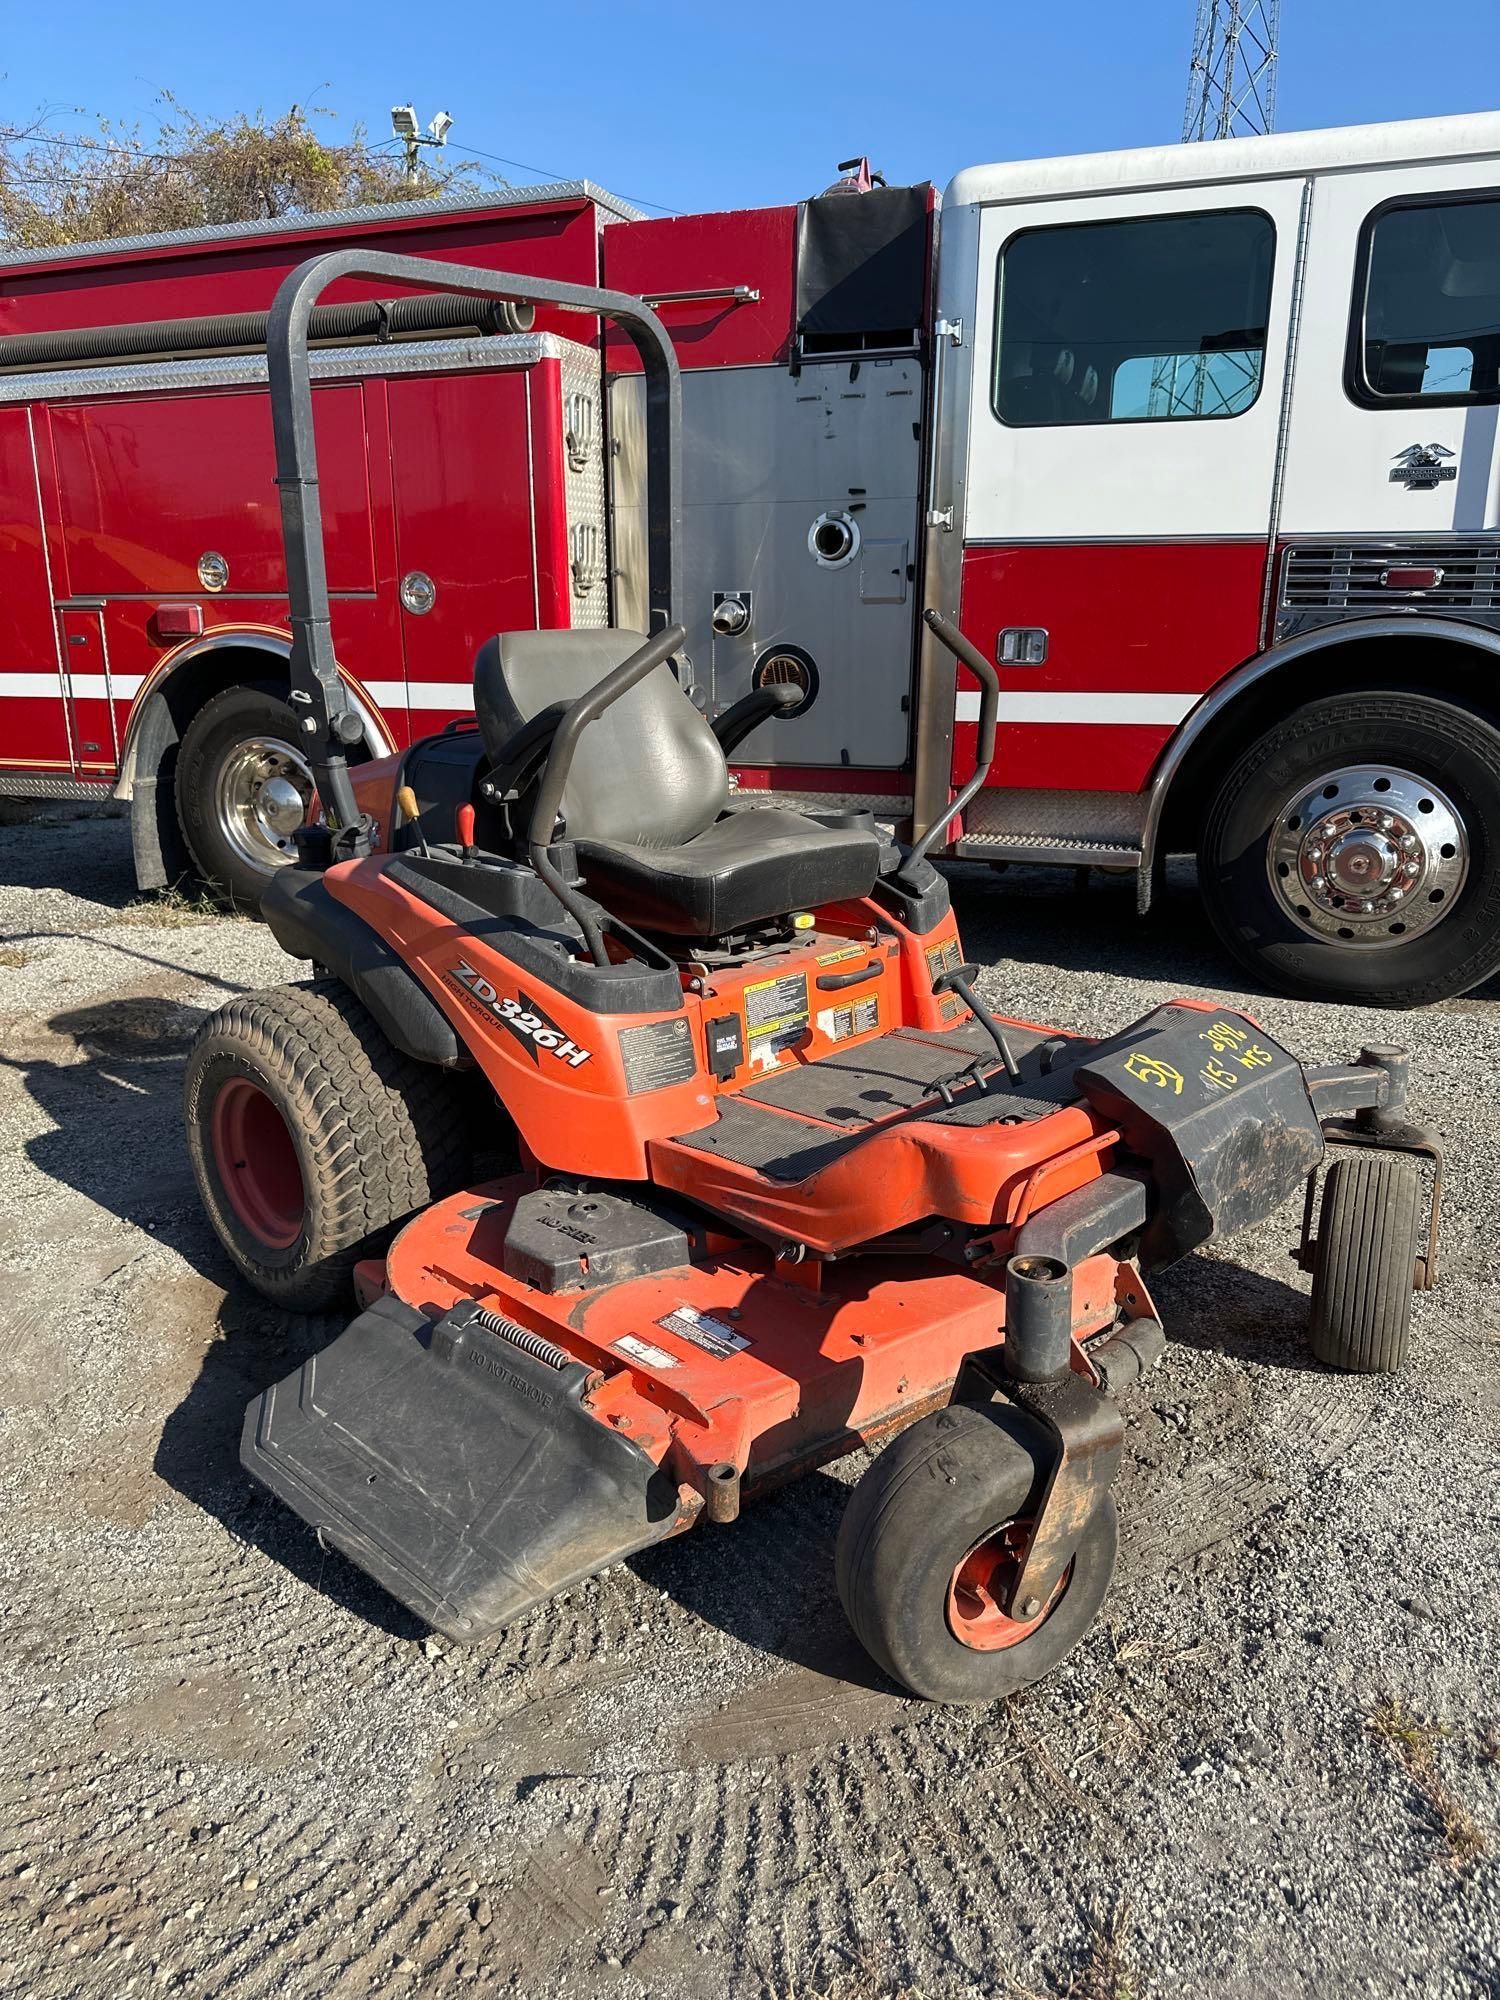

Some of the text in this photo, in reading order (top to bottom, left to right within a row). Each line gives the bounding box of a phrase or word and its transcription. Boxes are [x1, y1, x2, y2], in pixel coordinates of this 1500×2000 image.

[441, 975, 505, 1031] HIGH TORQUE
[449, 960, 593, 1068] ZD326H
[1230, 1044, 1274, 1071] hrs
[469, 1349, 554, 1409] DO NOT REMOVE
